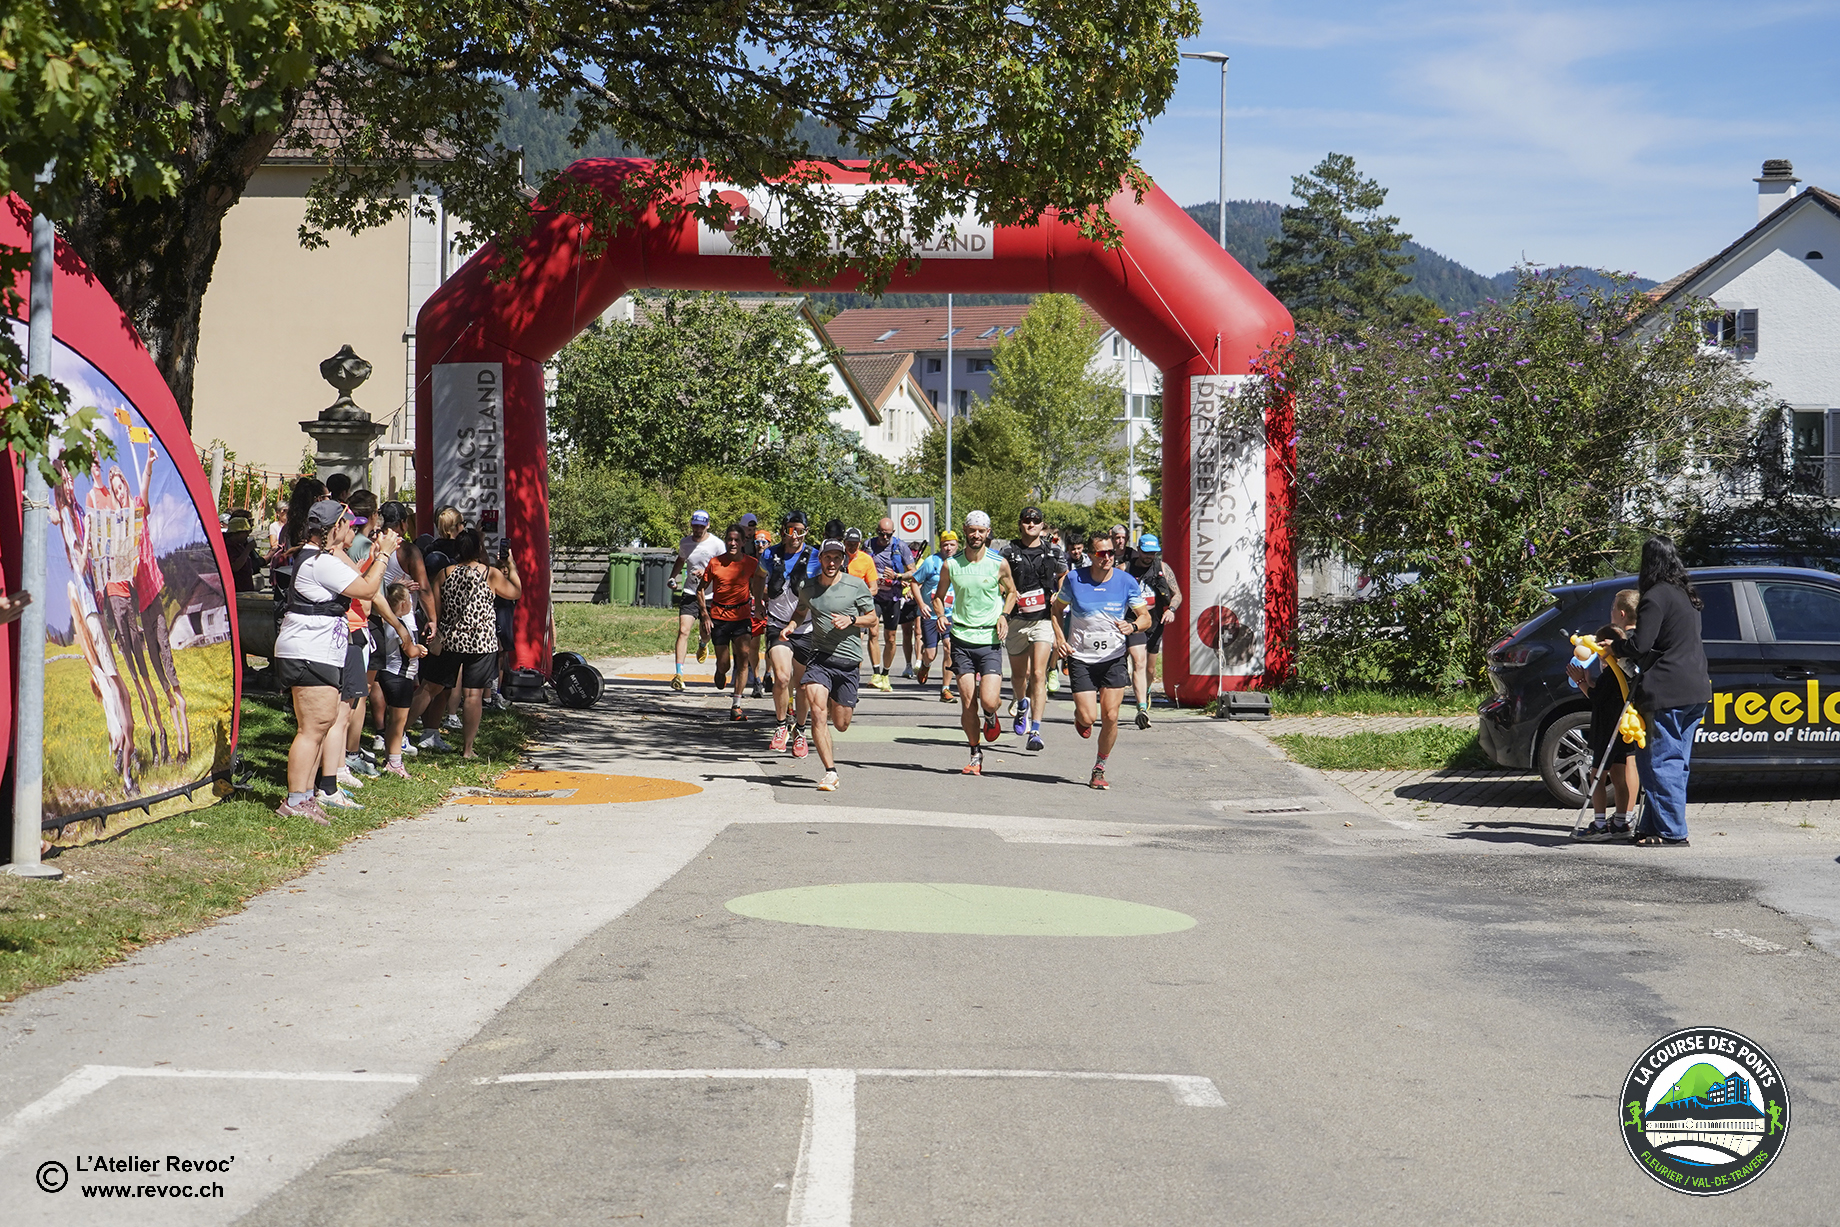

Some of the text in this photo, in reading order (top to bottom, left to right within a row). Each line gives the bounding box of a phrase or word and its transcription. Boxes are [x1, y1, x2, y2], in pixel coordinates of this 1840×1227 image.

[907, 517, 916, 527] 30
[1025, 597, 1037, 606] 65
[1093, 640, 1108, 651] 95
[1694, 727, 1769, 743] freedom
[1773, 727, 1794, 742] of
